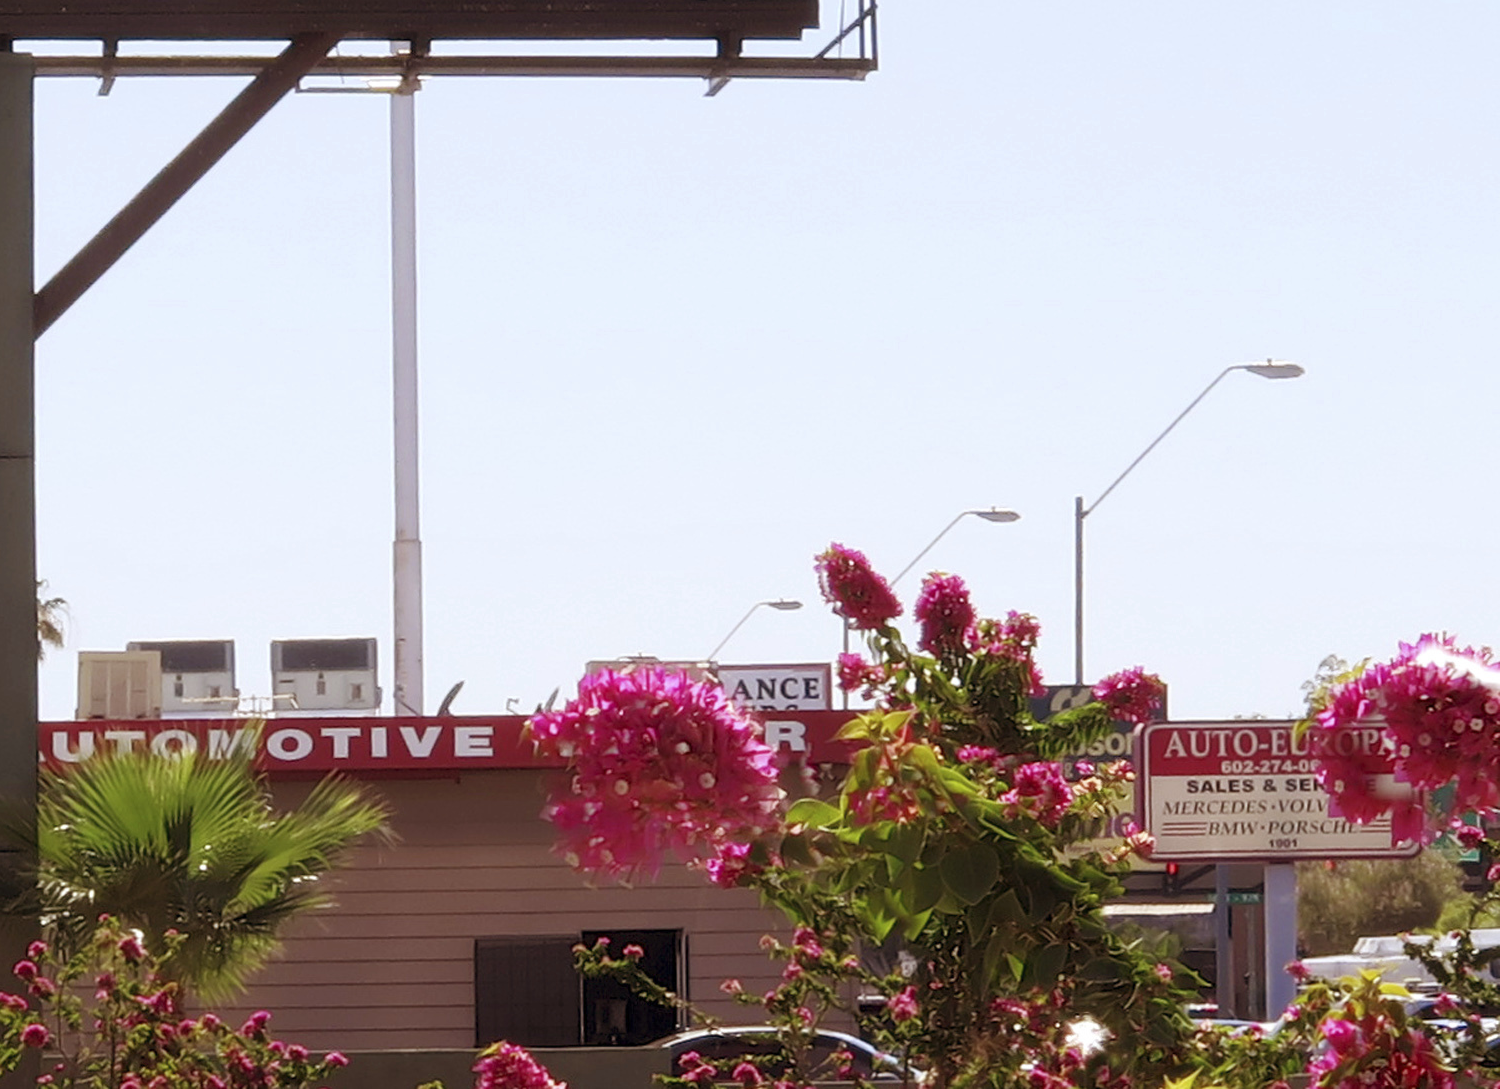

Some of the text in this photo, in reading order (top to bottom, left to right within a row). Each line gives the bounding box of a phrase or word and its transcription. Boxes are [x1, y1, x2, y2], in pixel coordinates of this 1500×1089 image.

[721, 677, 820, 700] ANCE
[38, 726, 495, 764] UTOMOTIVE
[1186, 779, 1255, 793] SALES
[1262, 779, 1277, 792] &
[1162, 799, 1329, 815] MERCEDES VOLV
[1208, 821, 1260, 835] BMW
